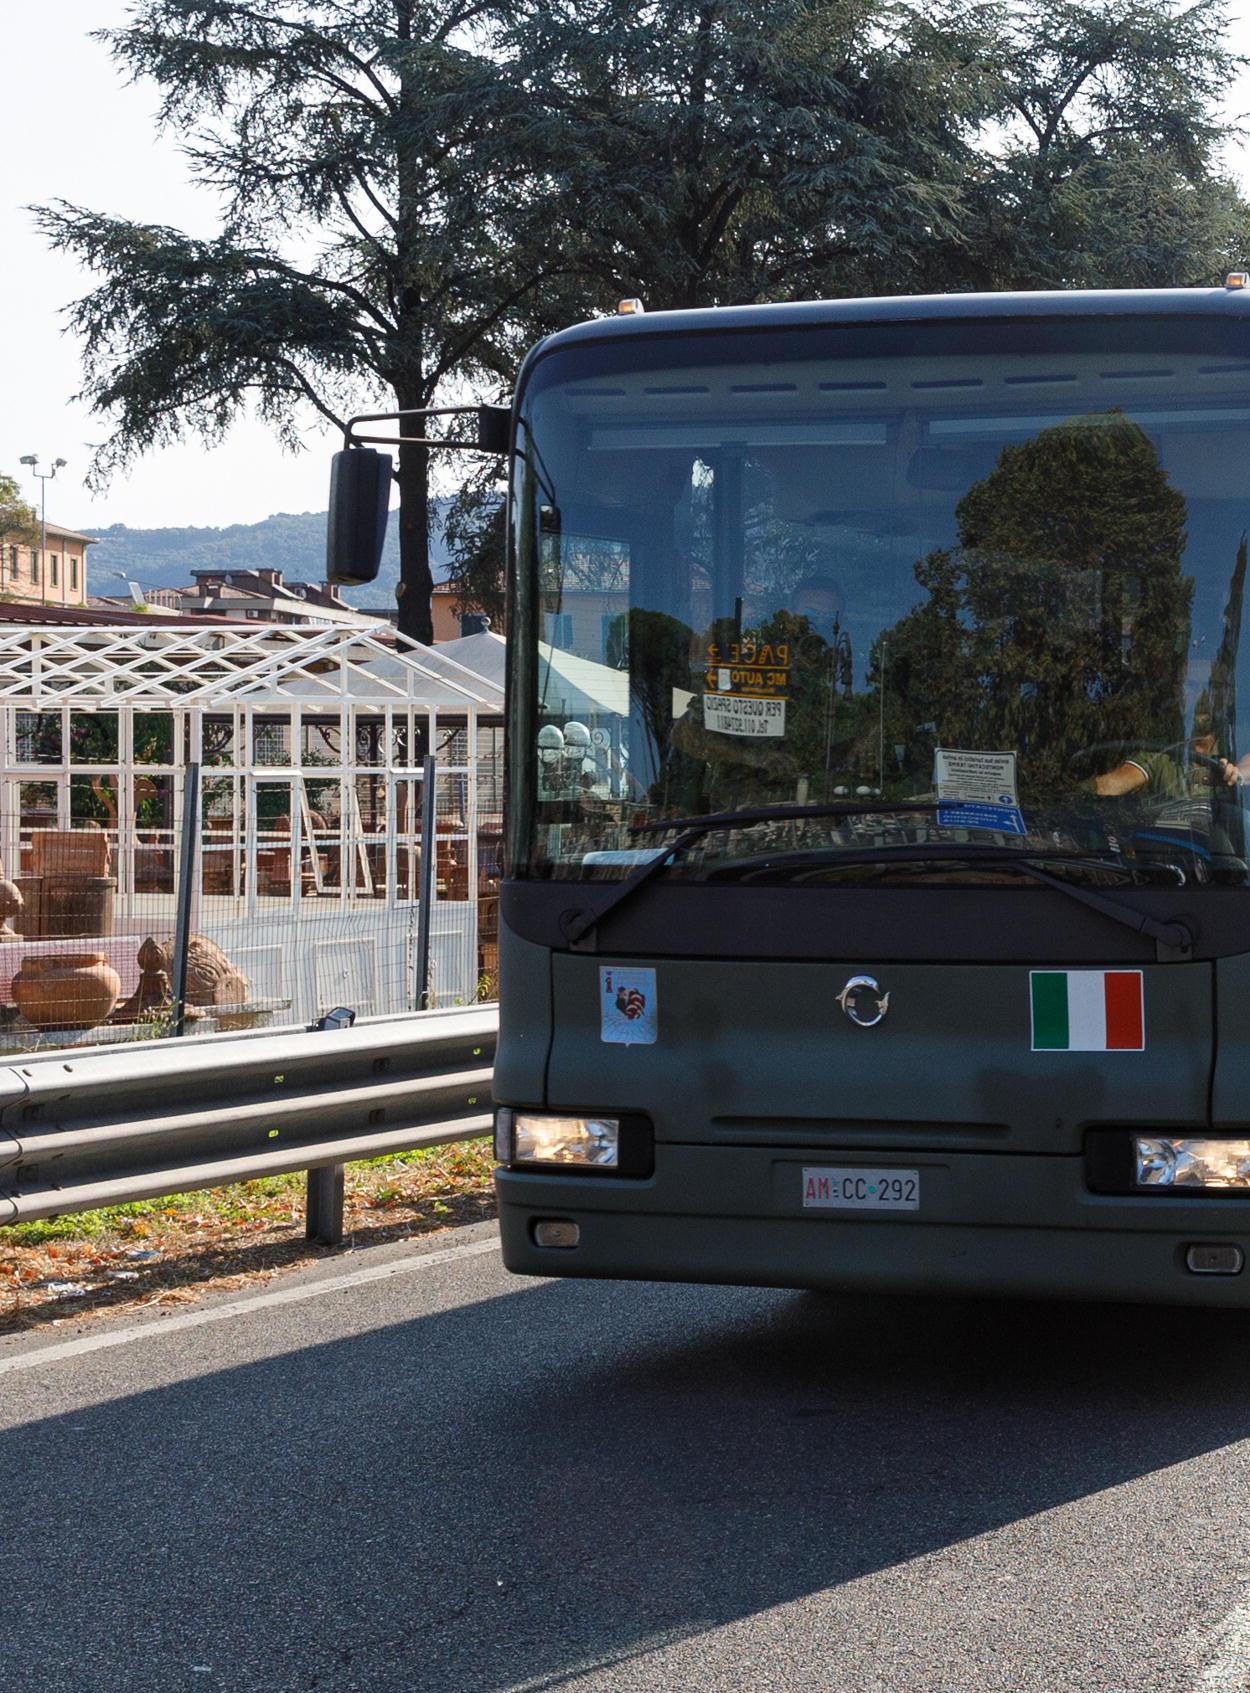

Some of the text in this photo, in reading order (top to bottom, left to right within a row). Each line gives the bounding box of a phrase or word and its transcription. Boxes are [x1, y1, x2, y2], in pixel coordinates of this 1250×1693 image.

[806, 1177, 916, 1201] AM CC 292
